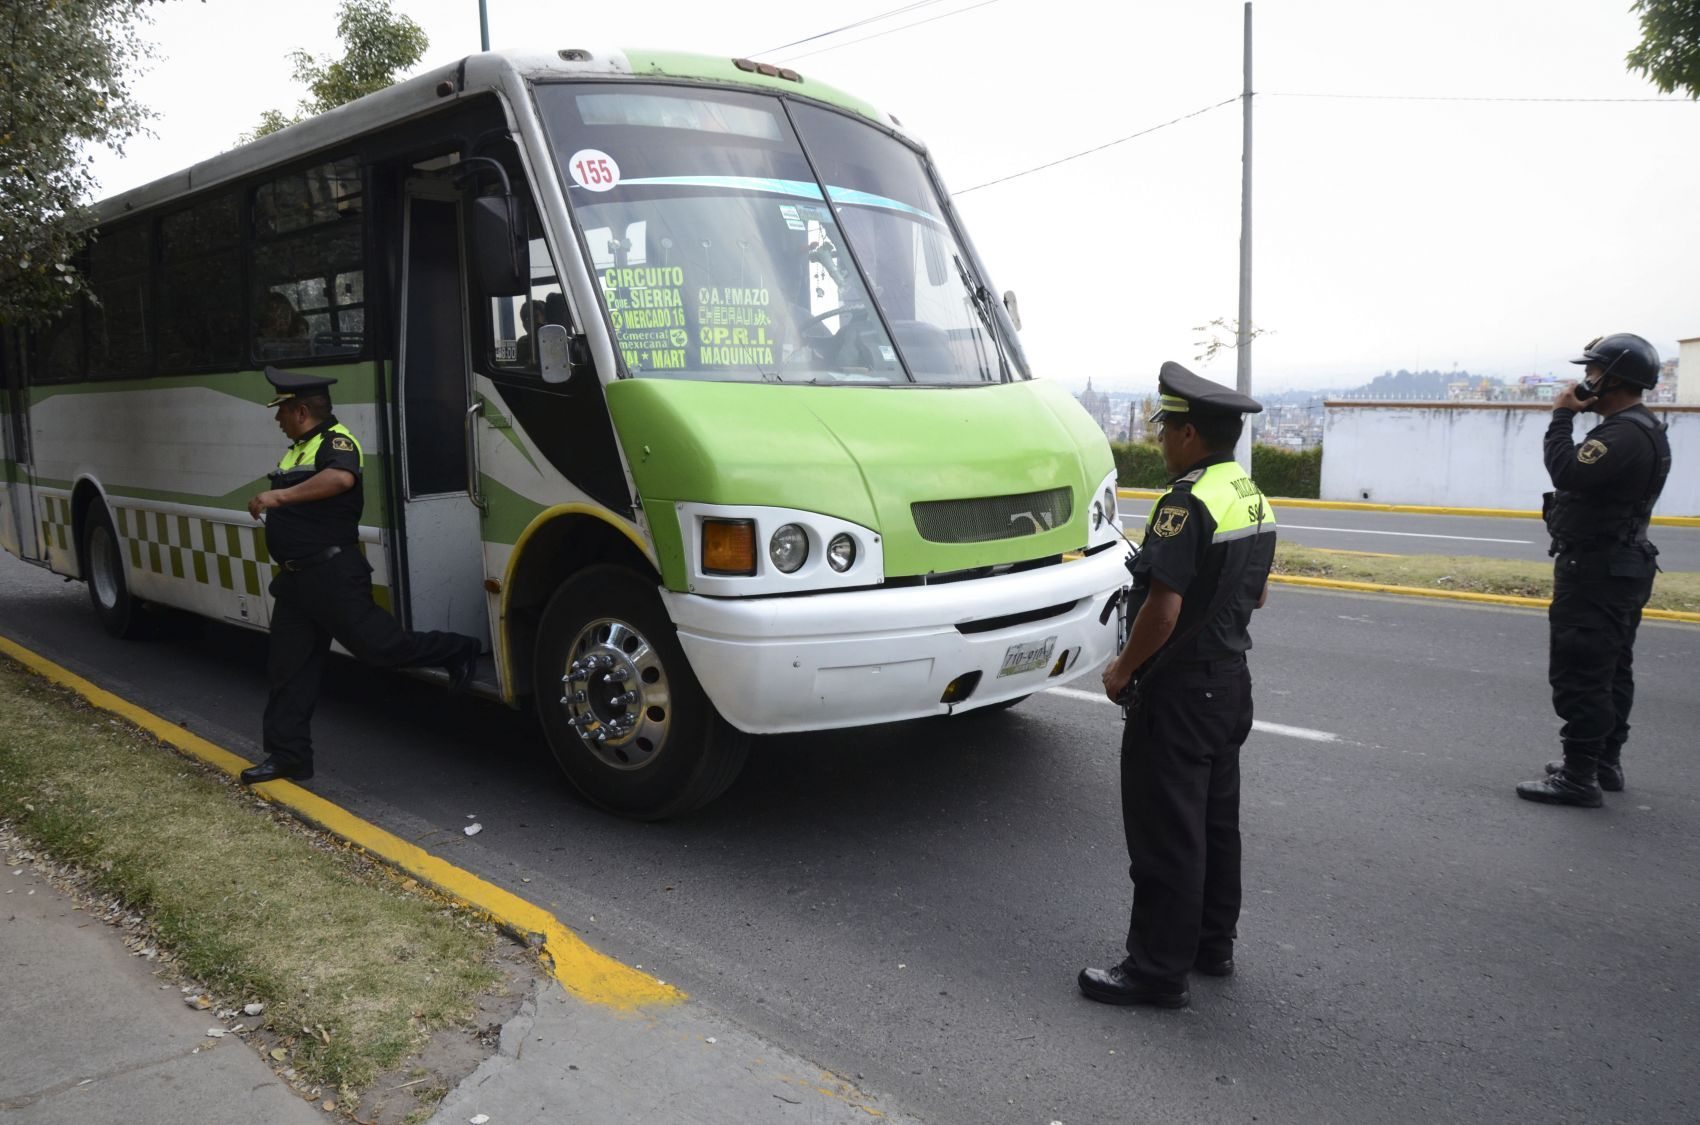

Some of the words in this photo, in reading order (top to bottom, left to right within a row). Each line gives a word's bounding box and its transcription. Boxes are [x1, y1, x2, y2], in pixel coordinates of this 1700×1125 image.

[576, 159, 613, 185] 155
[605, 266, 684, 288] CIRCUITO
[630, 288, 683, 308] SIERRA
[731, 288, 769, 305] MAZO
[624, 310, 671, 329] MERCADO
[673, 308, 685, 326] 16
[618, 339, 668, 349] mexicana
[651, 350, 686, 368] MART
[700, 346, 774, 365] MAQUINITA
